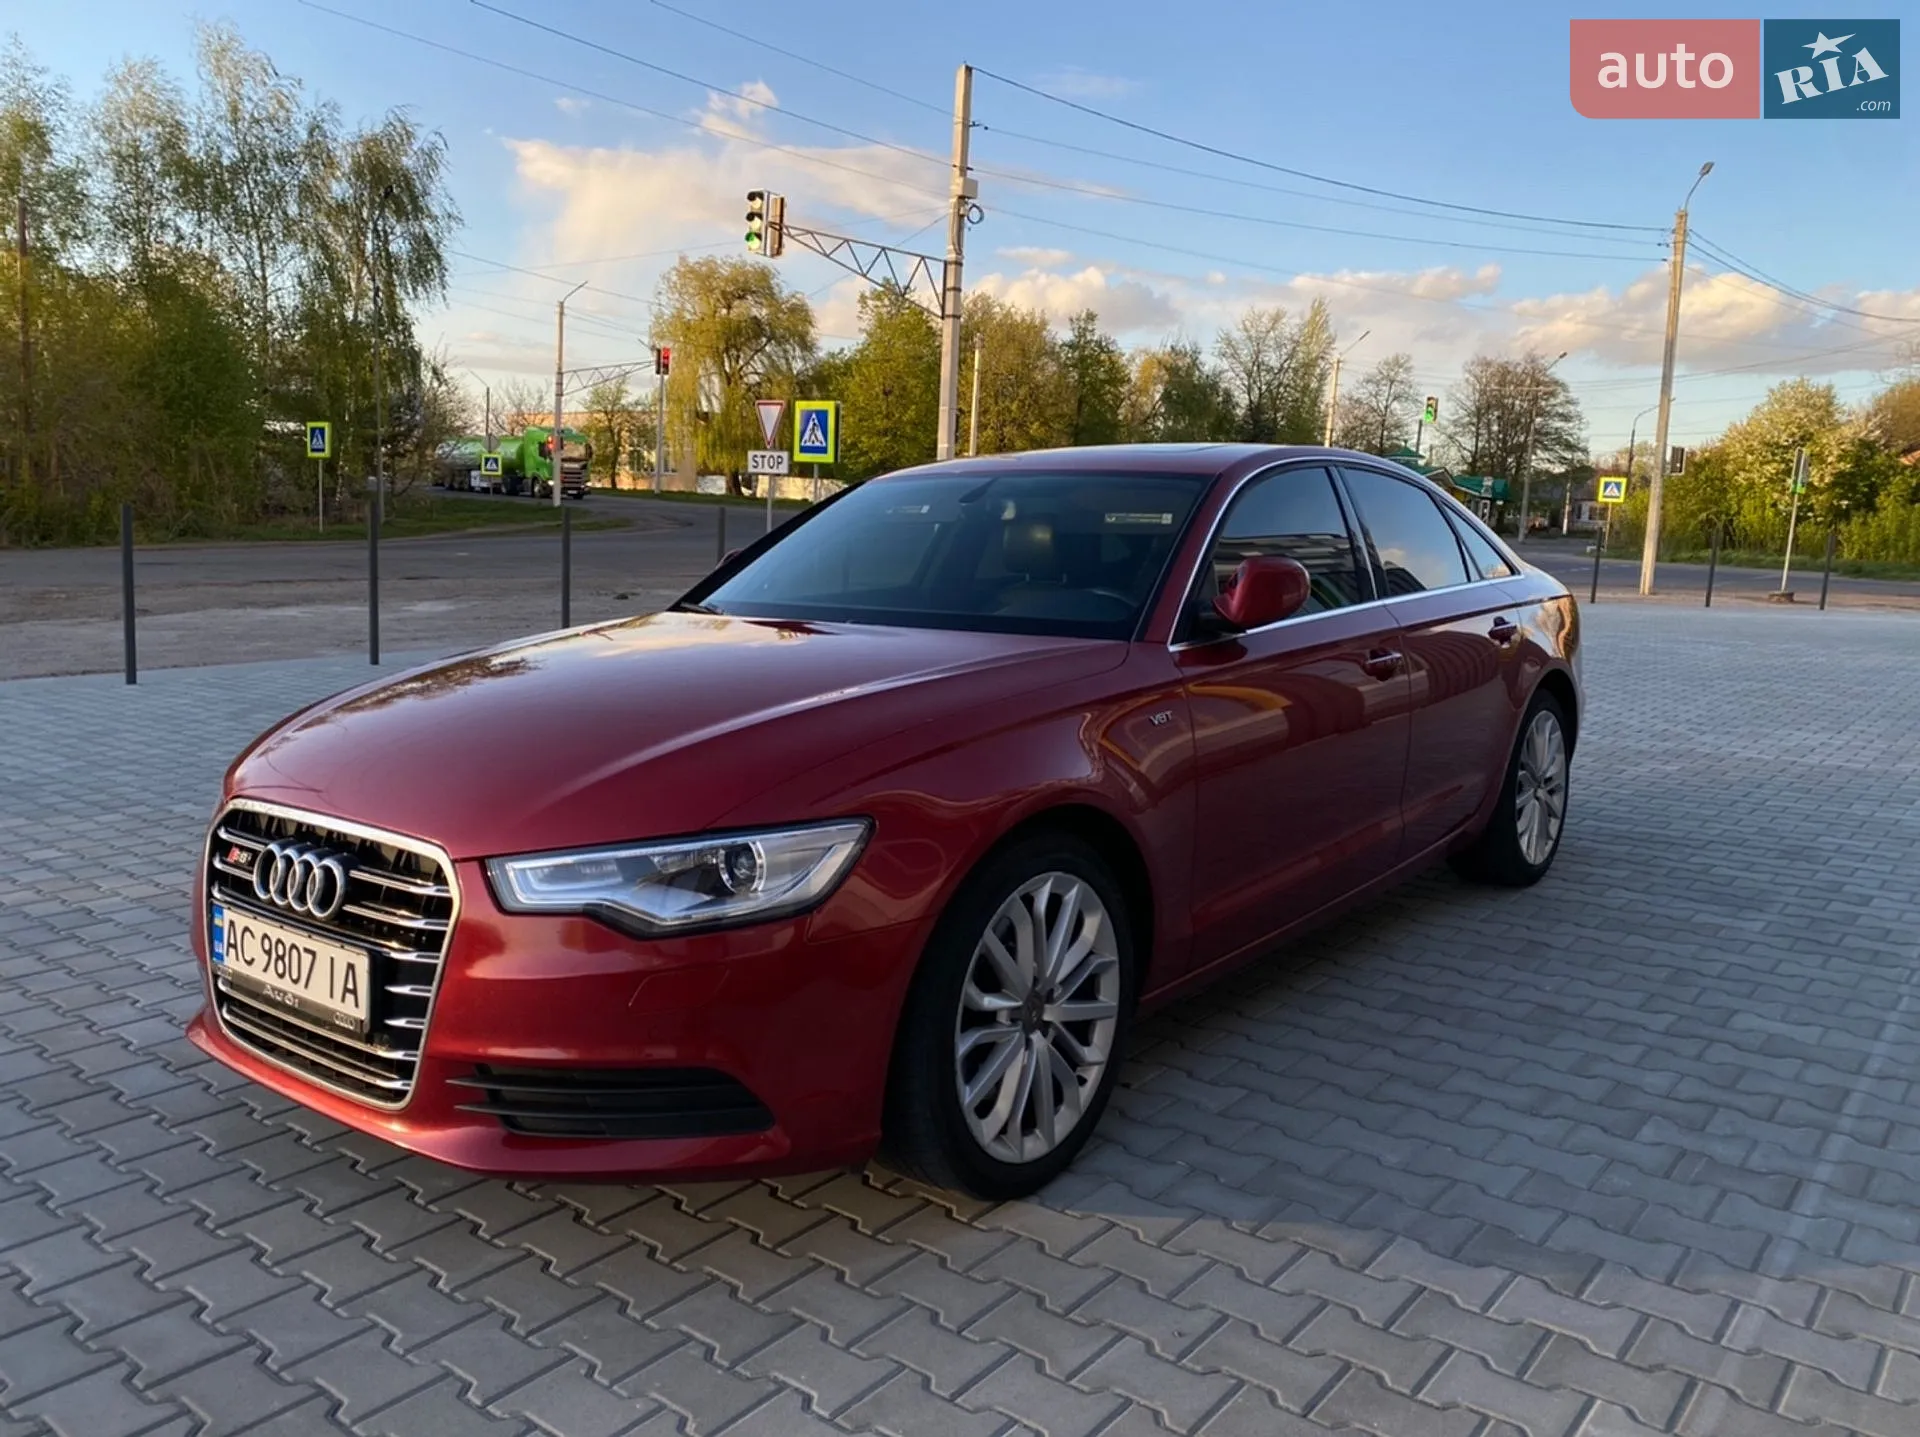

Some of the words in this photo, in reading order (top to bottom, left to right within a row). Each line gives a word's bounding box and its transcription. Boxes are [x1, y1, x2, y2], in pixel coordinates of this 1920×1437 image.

[751, 454, 784, 470] STOP
[225, 919, 255, 967] AC
[261, 932, 317, 989] 9807
[329, 956, 359, 1009] IA
